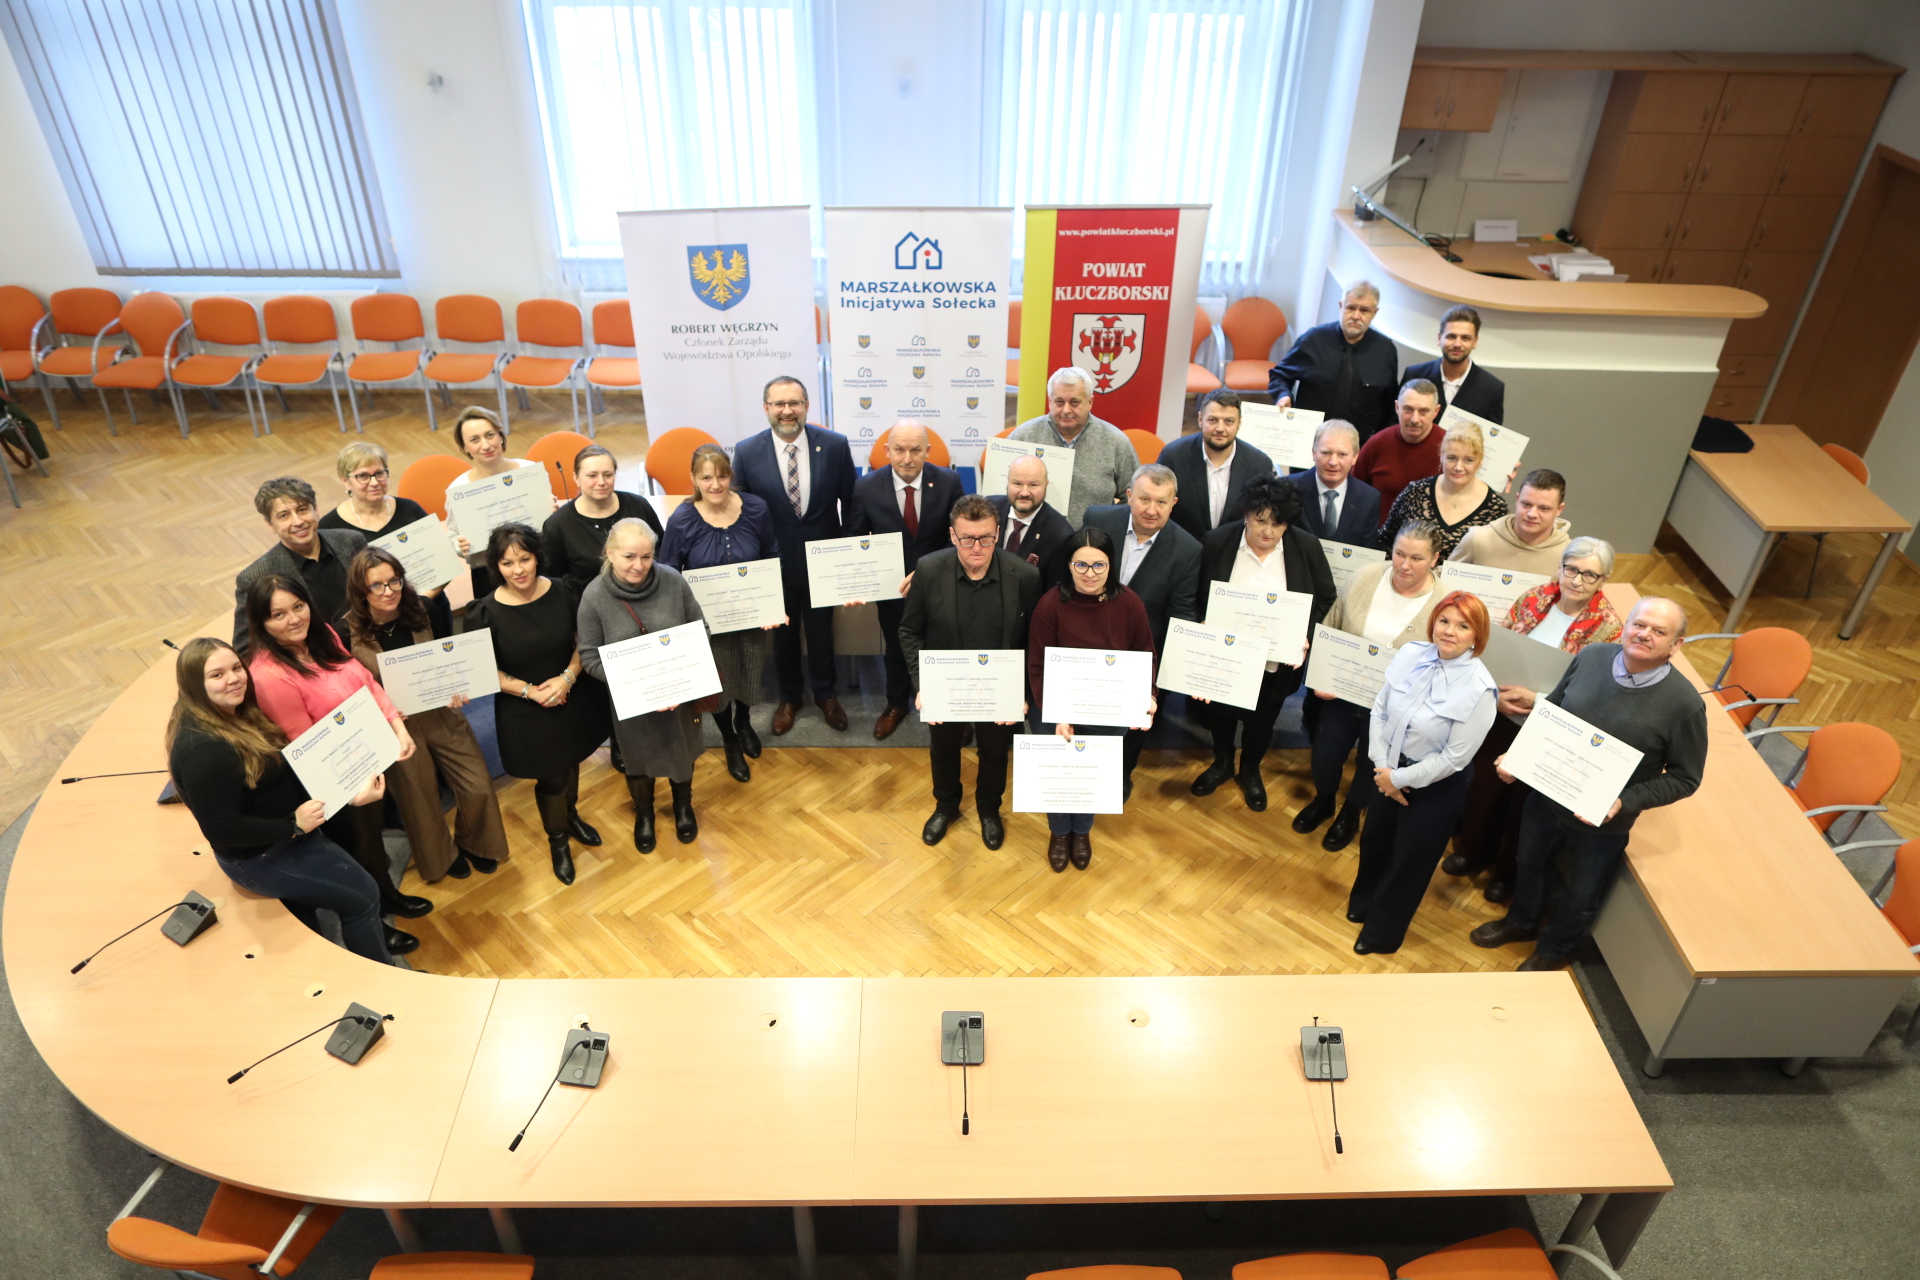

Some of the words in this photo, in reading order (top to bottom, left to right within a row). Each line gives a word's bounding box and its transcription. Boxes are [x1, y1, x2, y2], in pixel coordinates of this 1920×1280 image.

[1058, 228, 1174, 237] www.powiatkluczborski.pl
[1082, 262, 1146, 278] POWIAT
[840, 281, 997, 293] MARSZAŁKOWSKA
[1055, 285, 1170, 301] KLUCZBORSKI
[840, 297, 925, 311] Inicjatywa
[932, 297, 996, 309] Sołecka
[671, 324, 716, 334] ROBERT
[720, 322, 779, 335] WĘGRZYN
[684, 337, 725, 347] Członek
[728, 336, 768, 347] Zarządu
[663, 349, 734, 361] Województwa
[737, 348, 791, 360] Opolskiego
